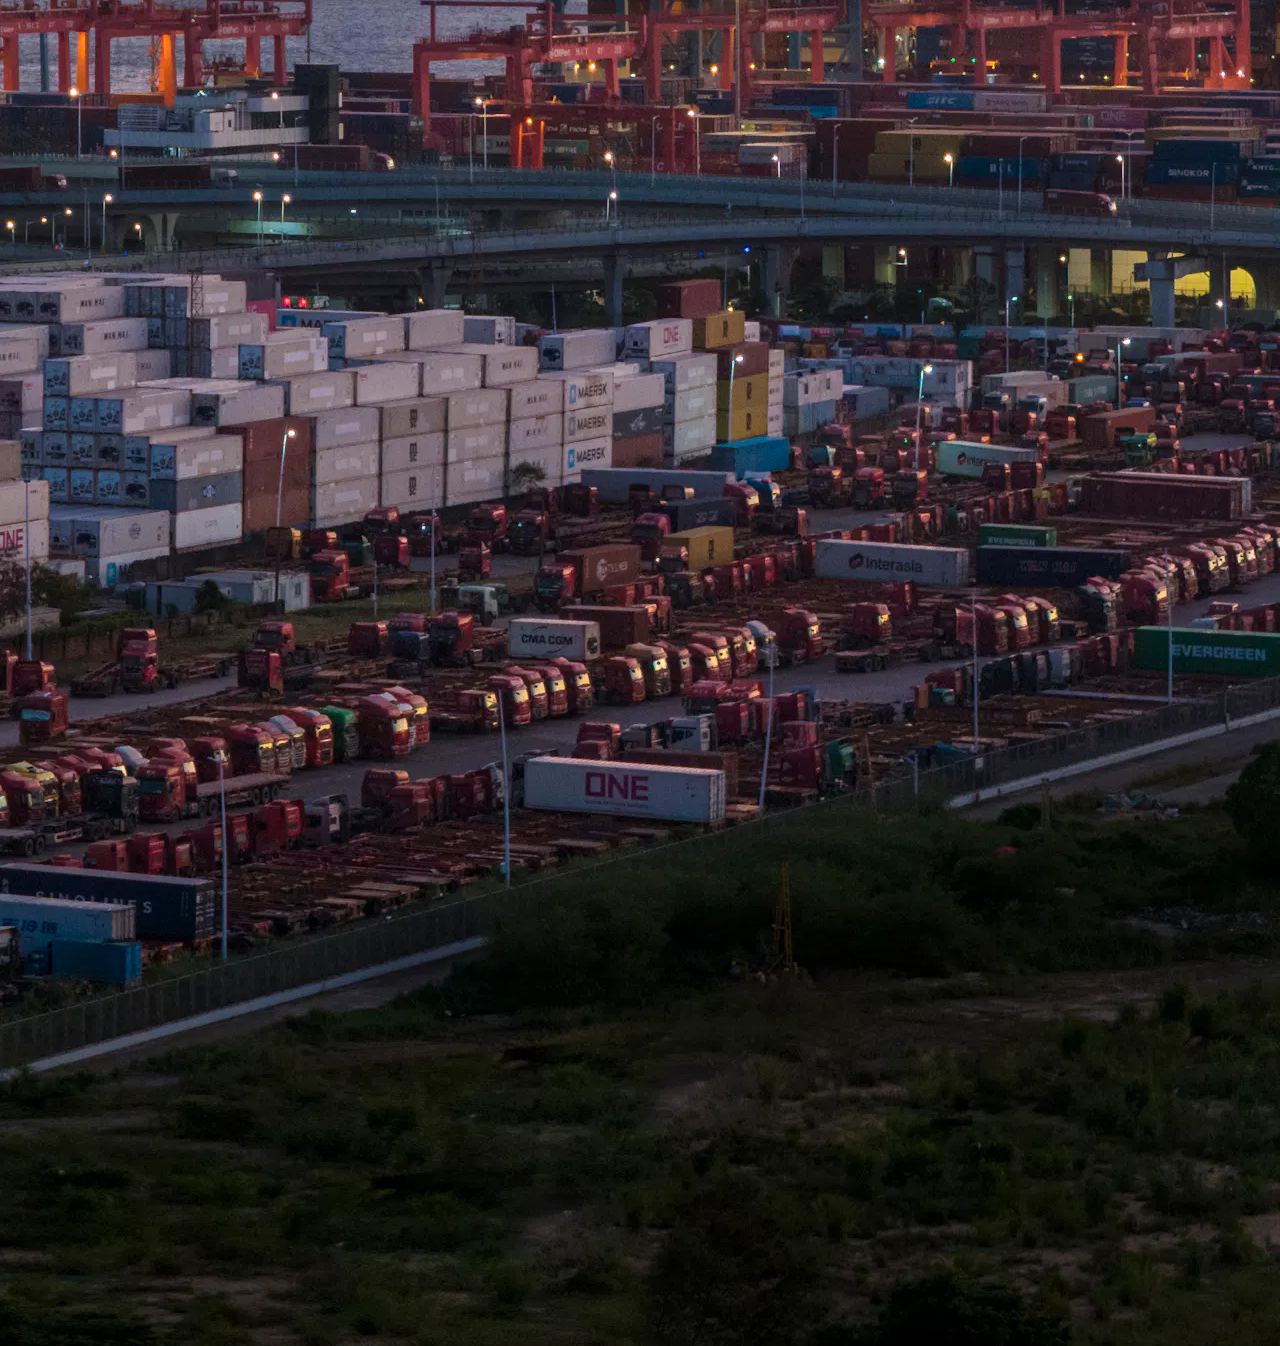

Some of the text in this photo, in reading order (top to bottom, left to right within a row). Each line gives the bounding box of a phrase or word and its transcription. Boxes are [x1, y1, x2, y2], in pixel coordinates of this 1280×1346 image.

[1101, 110, 1127, 122] ONE
[663, 326, 679, 344] ONE
[578, 383, 607, 398] MAERSK
[577, 415, 606, 430] MAERSK
[576, 447, 606, 463] MAERSK
[866, 557, 923, 574] Interasia
[521, 633, 573, 646] CMA CGM
[1170, 643, 1266, 662] EVERGREEN
[585, 771, 649, 802] ONE
